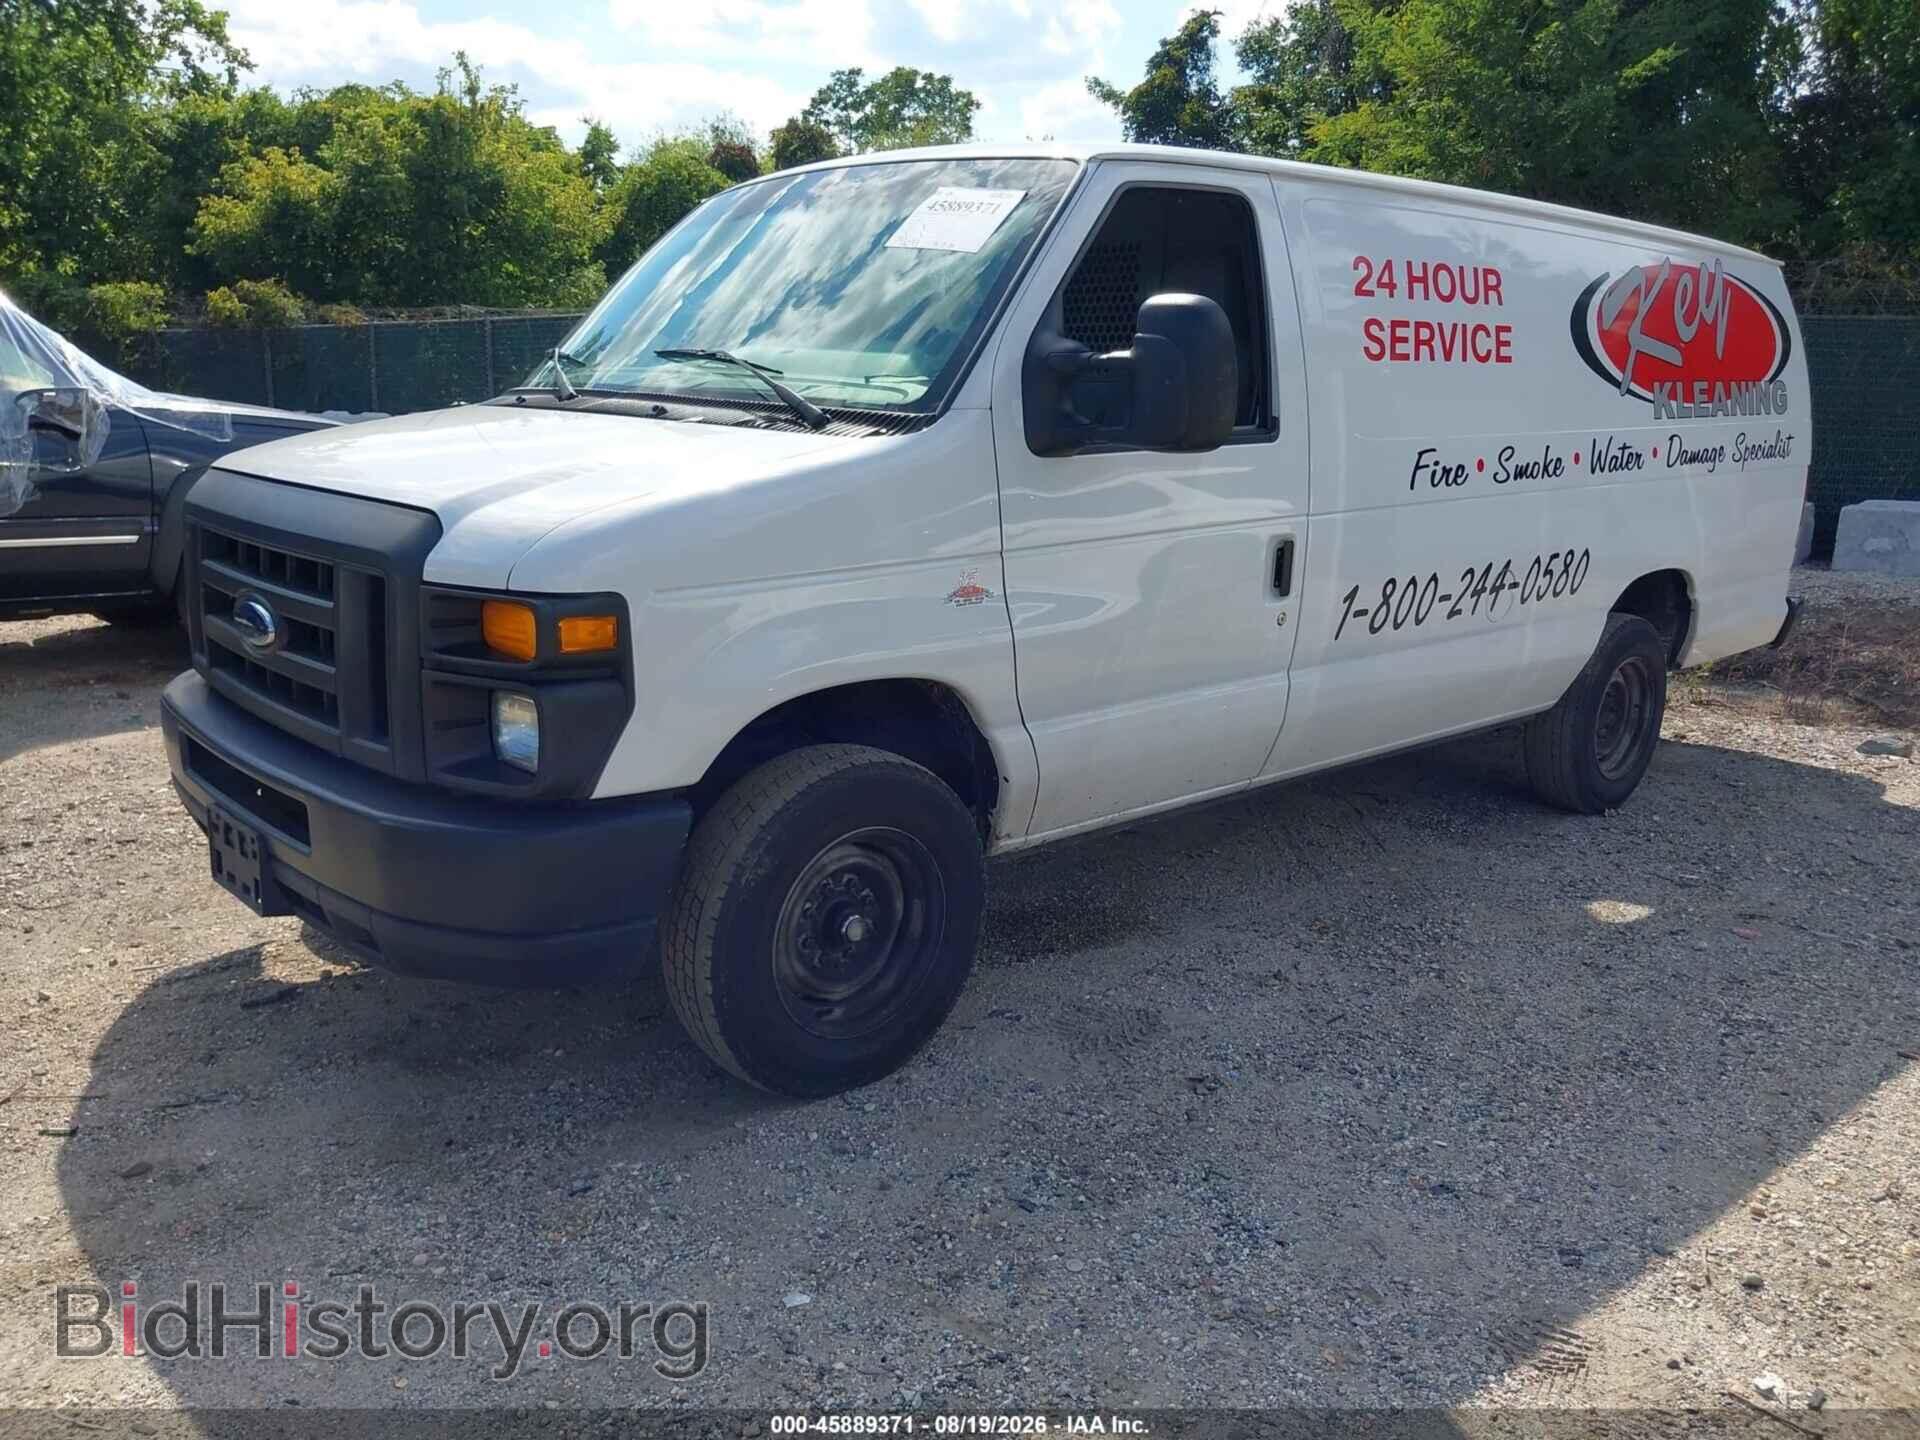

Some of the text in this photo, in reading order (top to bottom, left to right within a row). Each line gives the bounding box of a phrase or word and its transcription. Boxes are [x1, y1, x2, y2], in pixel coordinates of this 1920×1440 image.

[927, 199, 1000, 215] 45889371
[1352, 256, 1503, 306] 24 HOUR
[1363, 318, 1513, 363] SERVICE
[1601, 257, 1732, 397] Key
[1653, 379, 1789, 420] KLEANING
[1410, 432, 1795, 490] Fire Smoke Water Damage Specialist
[1334, 548, 1591, 641] 1-800-244-0580
